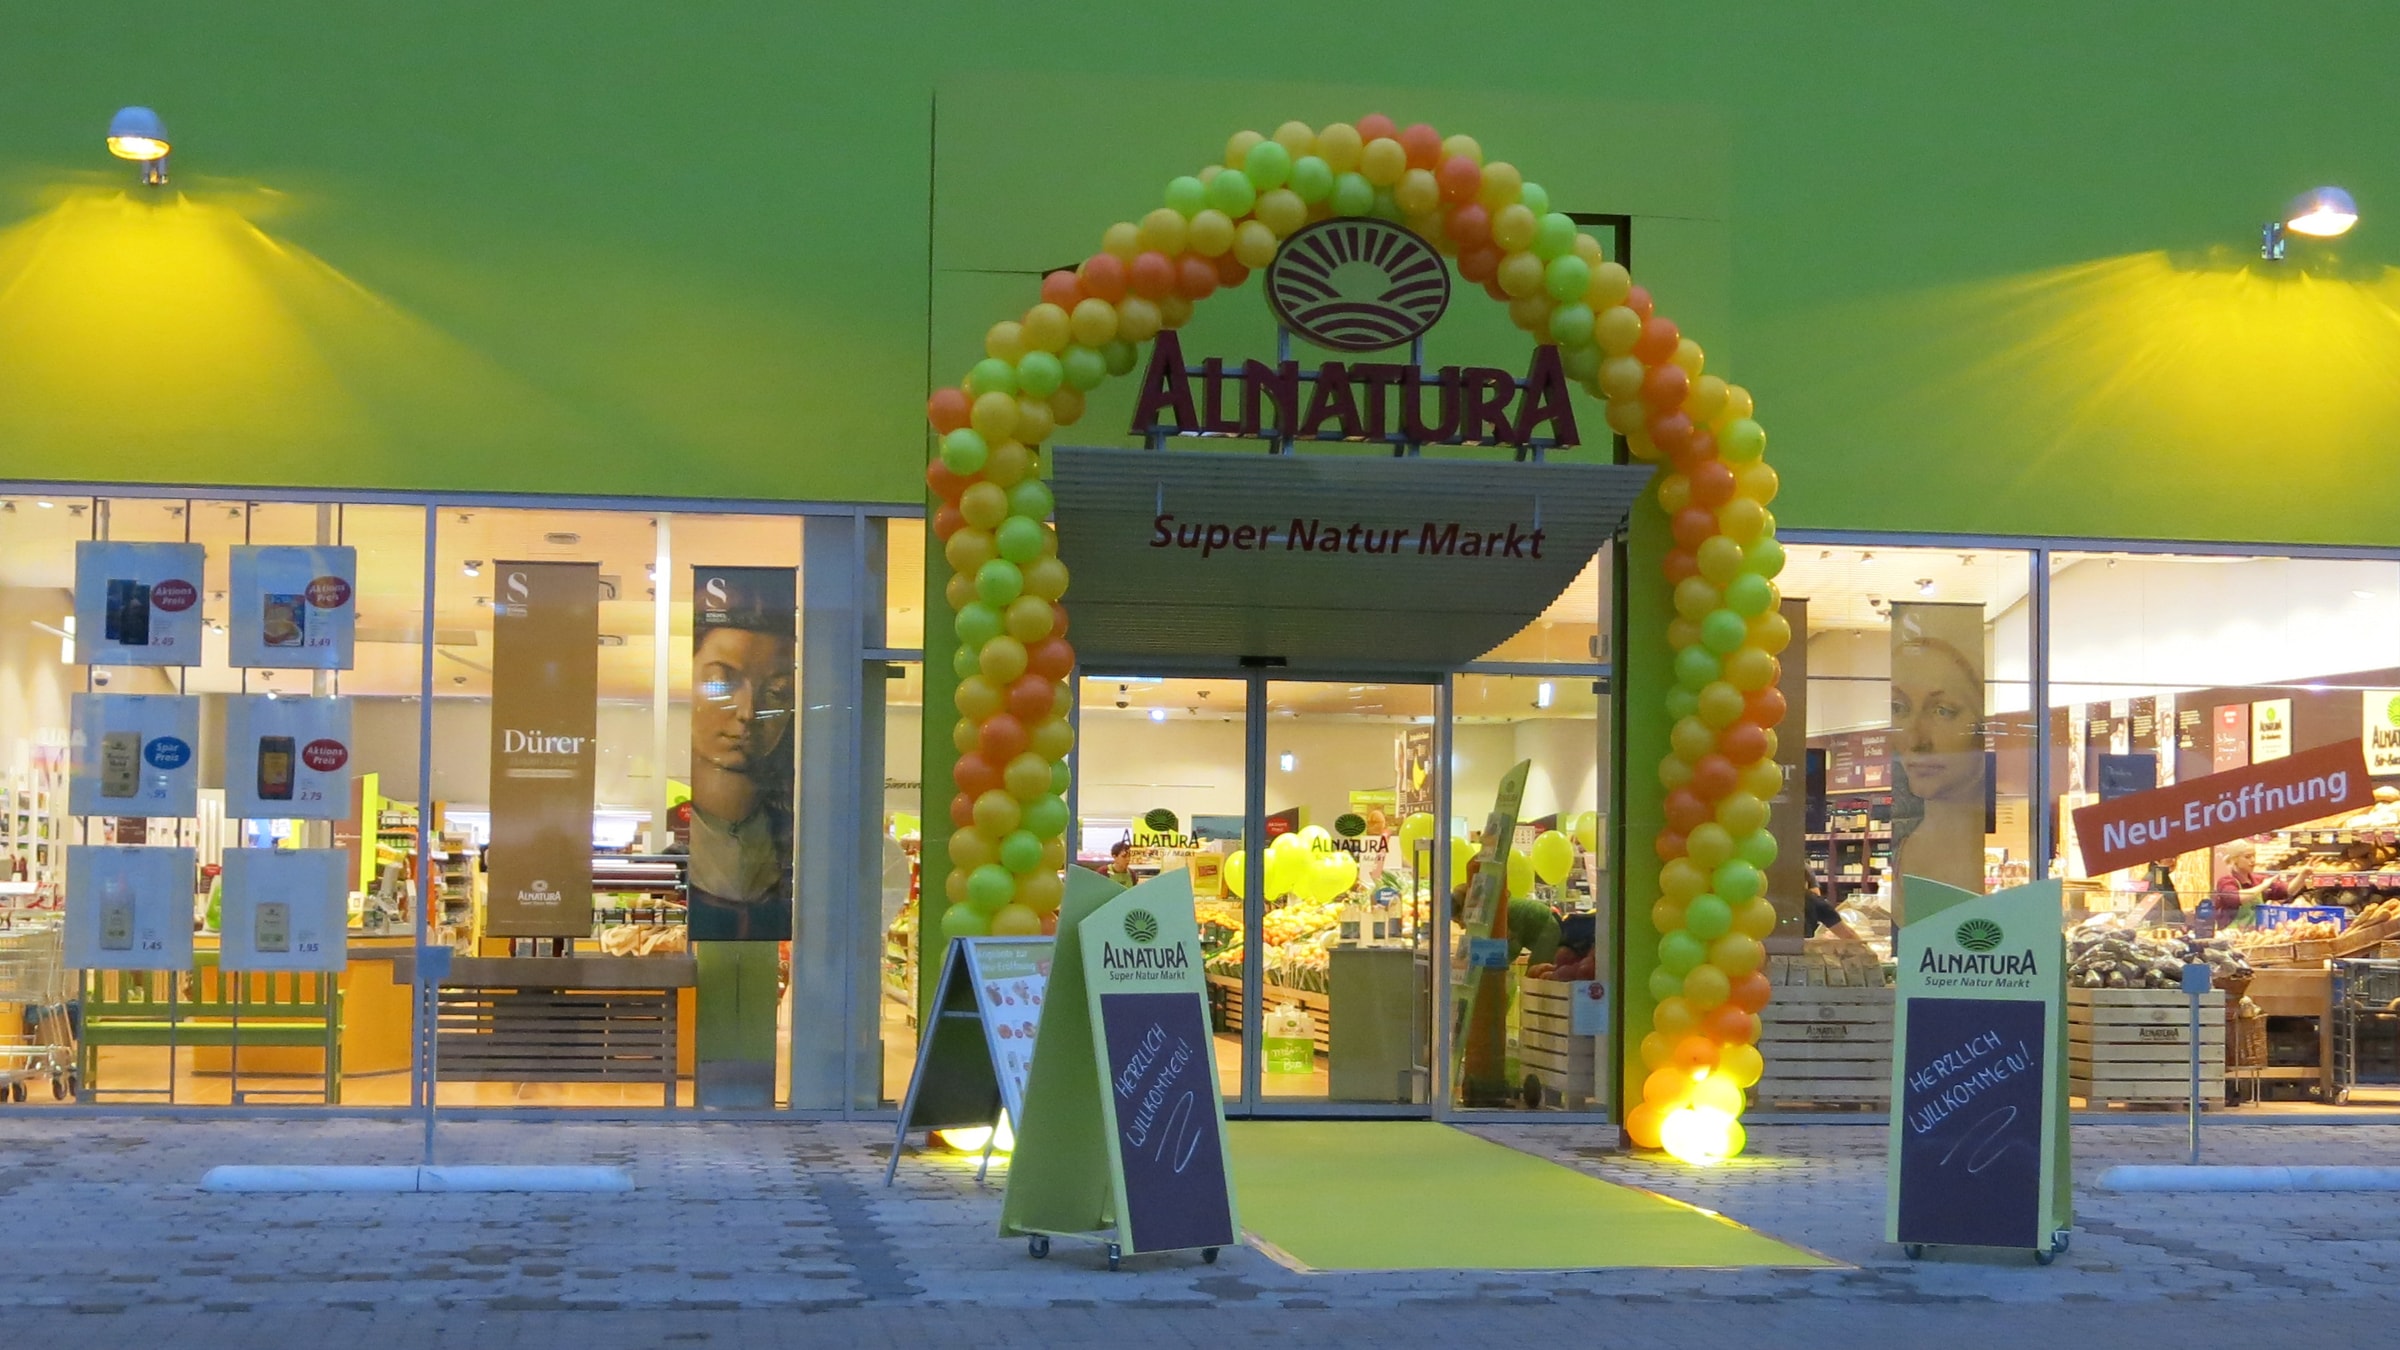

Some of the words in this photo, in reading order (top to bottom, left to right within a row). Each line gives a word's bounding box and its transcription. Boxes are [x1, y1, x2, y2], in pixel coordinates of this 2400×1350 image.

[1128, 329, 1581, 448] ALNATURA
[1149, 514, 1276, 558] Super
[1286, 518, 1408, 554] Natur
[1417, 522, 1546, 560] Markt
[156, 586, 192, 596] Aktions
[309, 584, 345, 594] Aktions
[162, 597, 186, 605] Preis
[156, 742, 179, 754] Spar
[503, 728, 586, 754] Dürer
[155, 753, 180, 763] Preis
[307, 745, 343, 756] Aktions
[313, 756, 336, 765] Preis
[301, 791, 322, 801] 2.79
[2103, 769, 2349, 852] Neu-Eröffnung
[1121, 828, 1199, 849] ALNATURA
[1311, 835, 1389, 853] ALNATURA
[299, 943, 320, 953] 1.95
[1103, 941, 1188, 969] ALNATURA
[1919, 946, 2037, 976] ALNATURA
[1110, 970, 1134, 982] Super
[1135, 970, 1159, 980] Natur
[1160, 970, 1185, 980] Markt
[1925, 976, 1957, 988] Super
[1960, 977, 1993, 988] Natur
[1995, 978, 2030, 989] Markt
[1115, 1022, 1167, 1099] HERZLICH
[1909, 1029, 2002, 1093] HERZLICH
[1126, 1036, 1193, 1147] WILLKOMMEN!
[1908, 1040, 2035, 1133] WILLKOMMEN!
